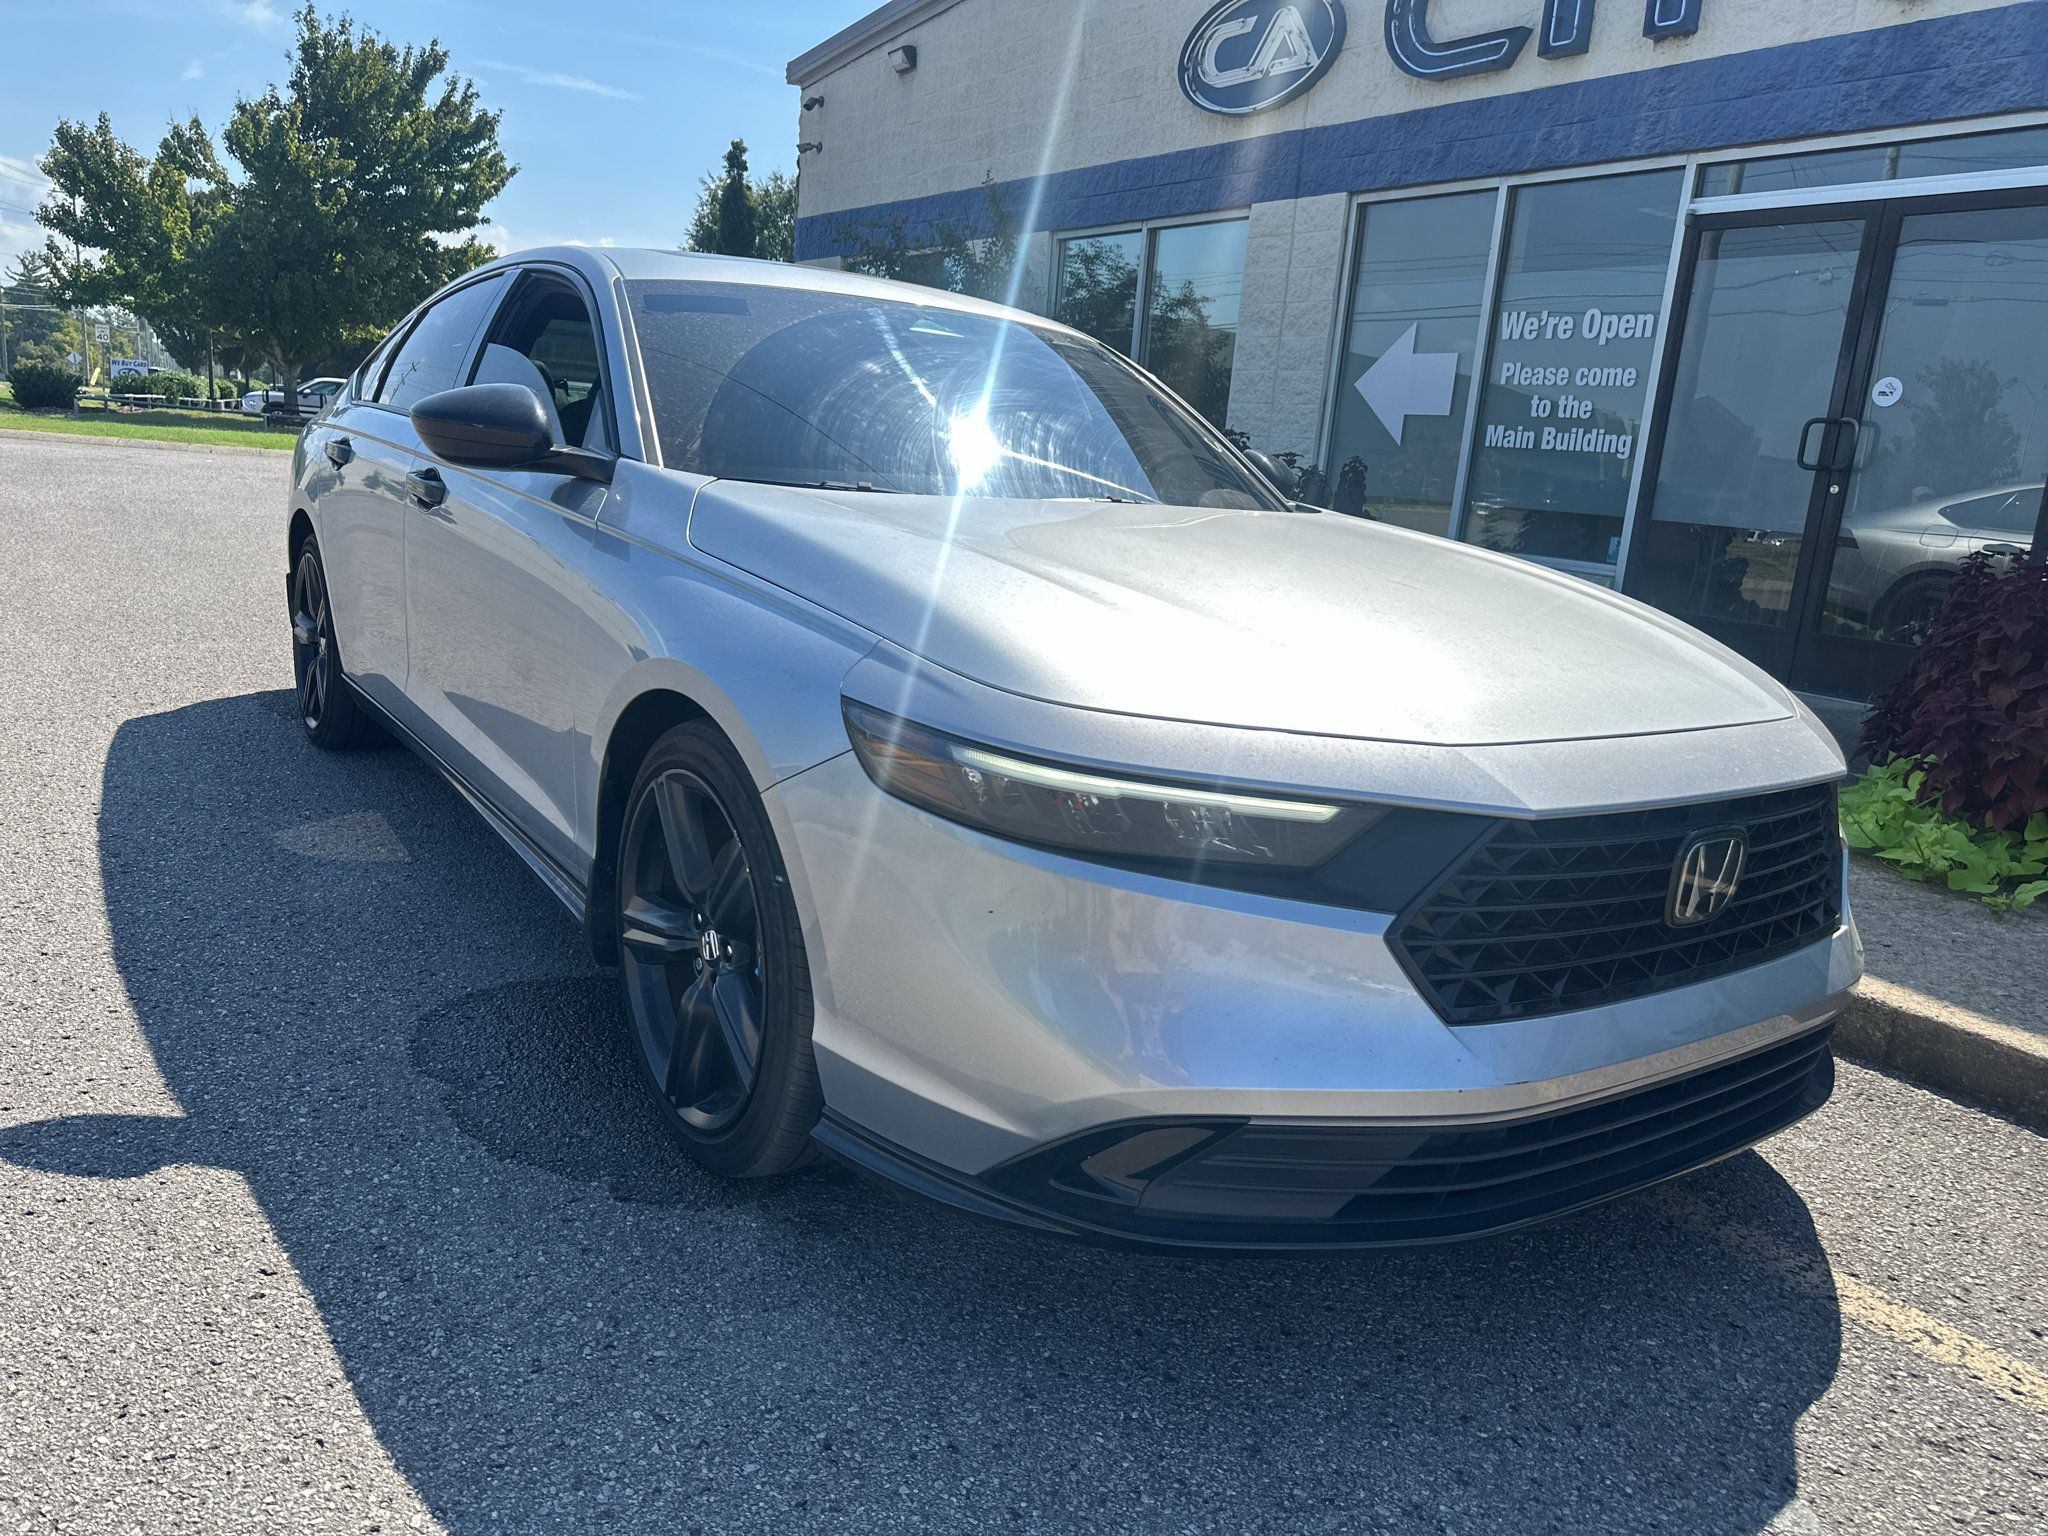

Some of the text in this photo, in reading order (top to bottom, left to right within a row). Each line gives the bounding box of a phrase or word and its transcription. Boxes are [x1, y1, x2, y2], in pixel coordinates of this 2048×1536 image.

[1501, 307, 1655, 346] We're Open
[1500, 362, 1638, 387] Please come
[1530, 395, 1593, 419] to the
[1484, 424, 1633, 460] Main Building
